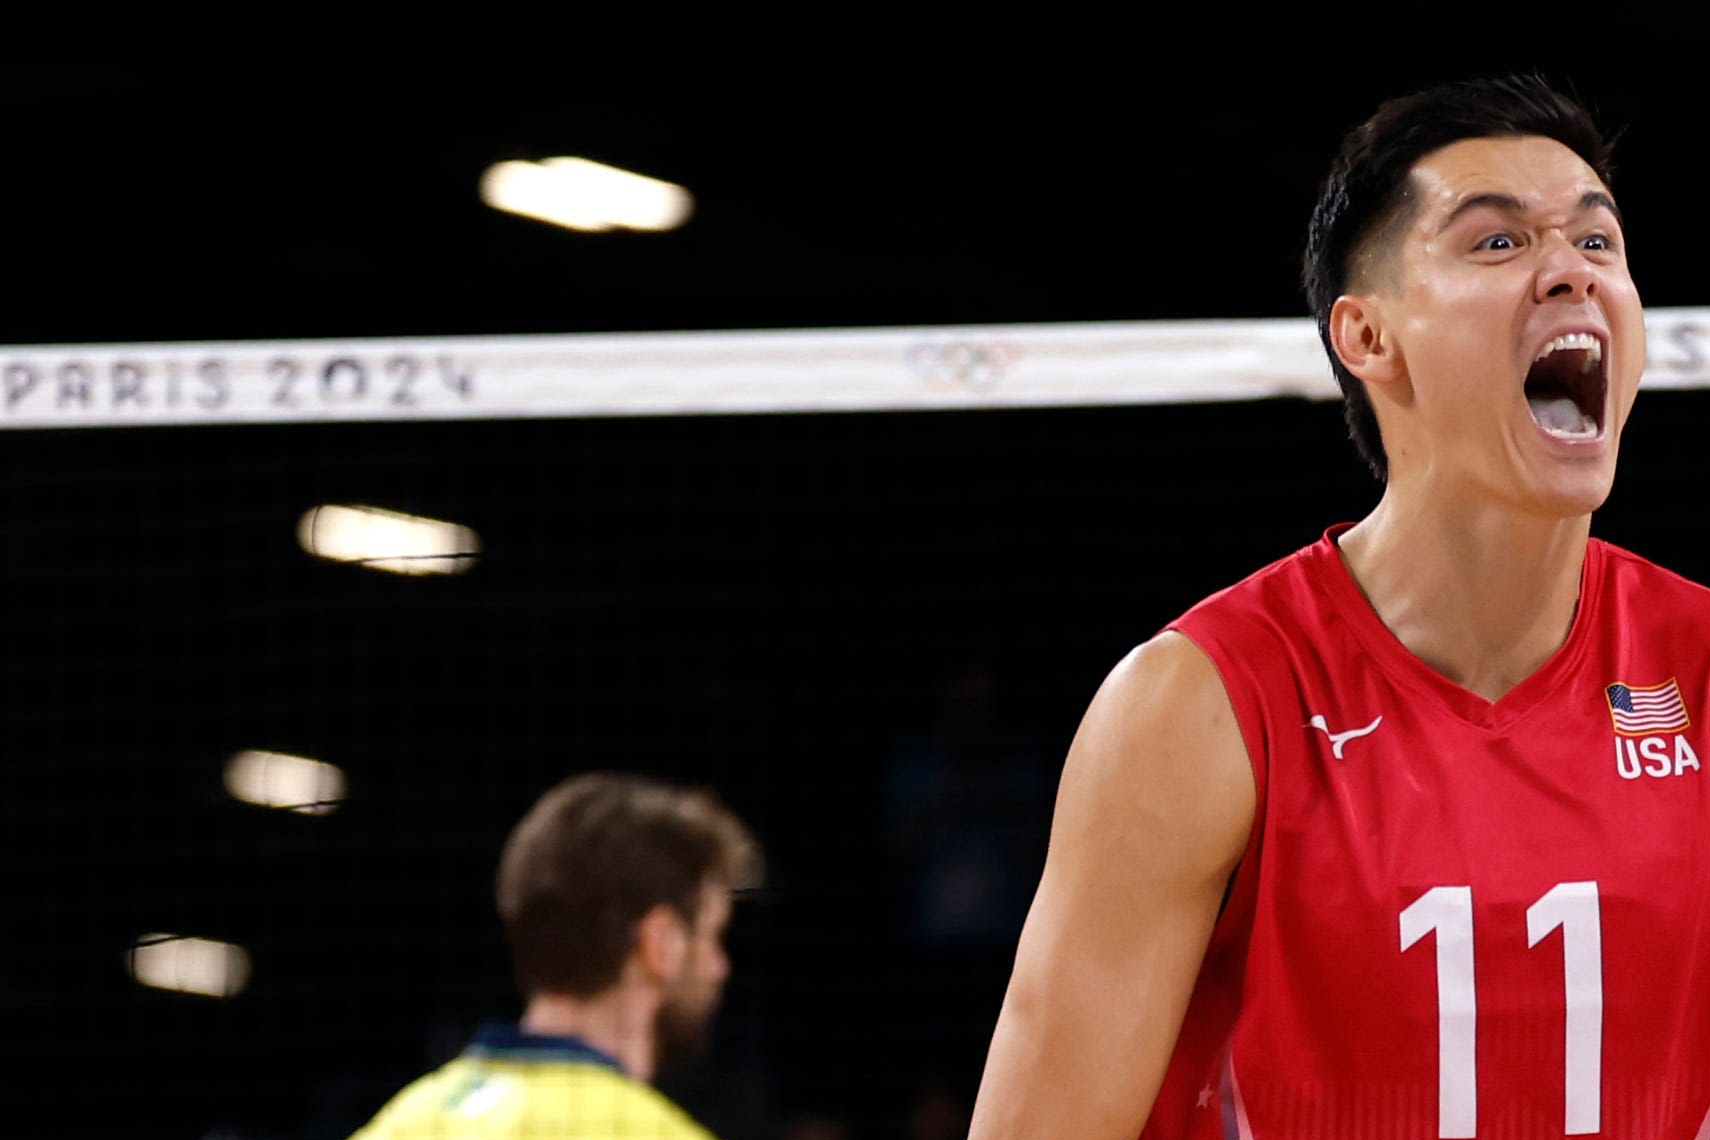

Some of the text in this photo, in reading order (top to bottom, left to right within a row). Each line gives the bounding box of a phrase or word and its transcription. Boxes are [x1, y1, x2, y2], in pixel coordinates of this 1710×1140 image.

[2, 353, 474, 411] PARIS 2024
[1614, 734, 1700, 779] USA
[1399, 881, 1603, 1140] 11
